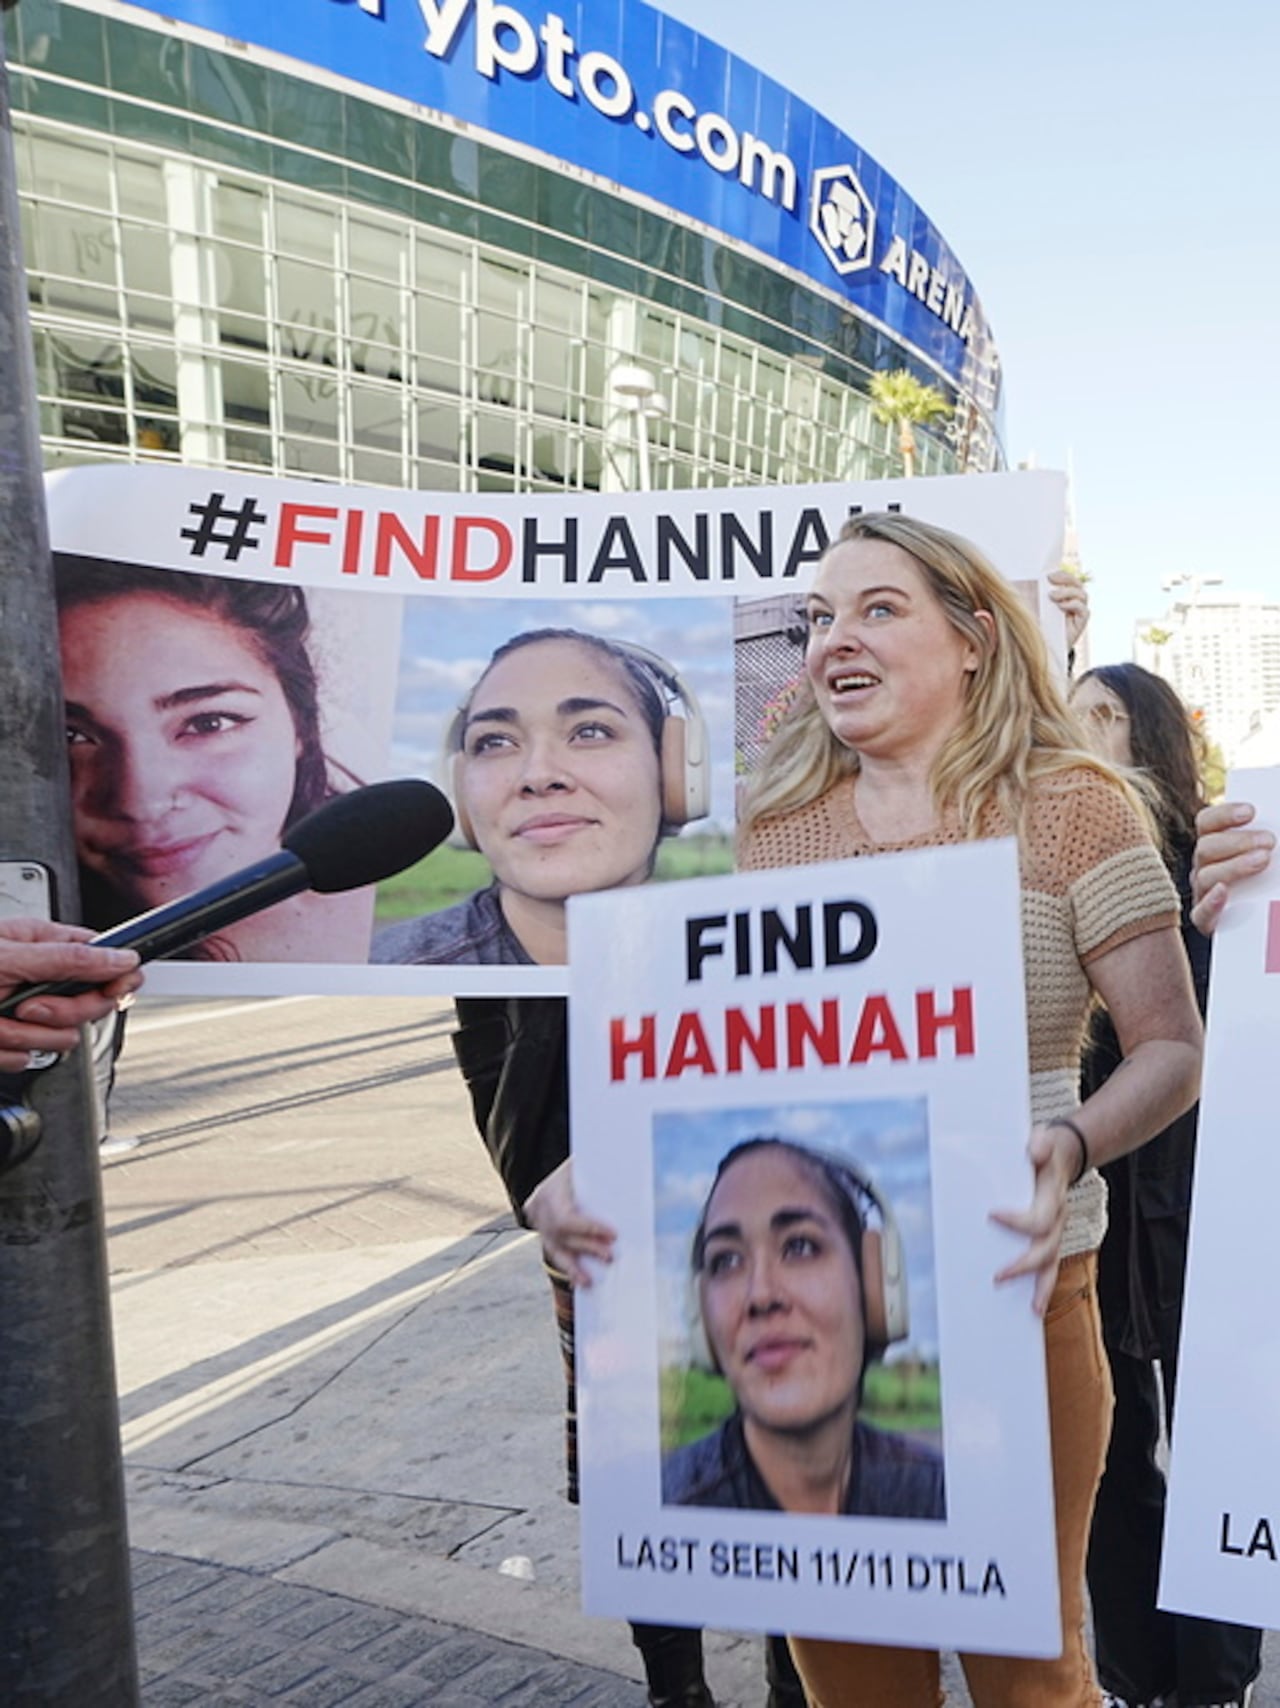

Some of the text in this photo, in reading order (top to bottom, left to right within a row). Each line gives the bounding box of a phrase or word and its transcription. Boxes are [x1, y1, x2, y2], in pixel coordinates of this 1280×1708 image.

[358, 0, 975, 346] ypto.com ARENA
[180, 492, 902, 583] #FINDHANNA
[685, 899, 879, 984] FIND
[609, 985, 976, 1083] HANNAH
[616, 1534, 1007, 1598] LAST SEEN 11/11 DTLA
